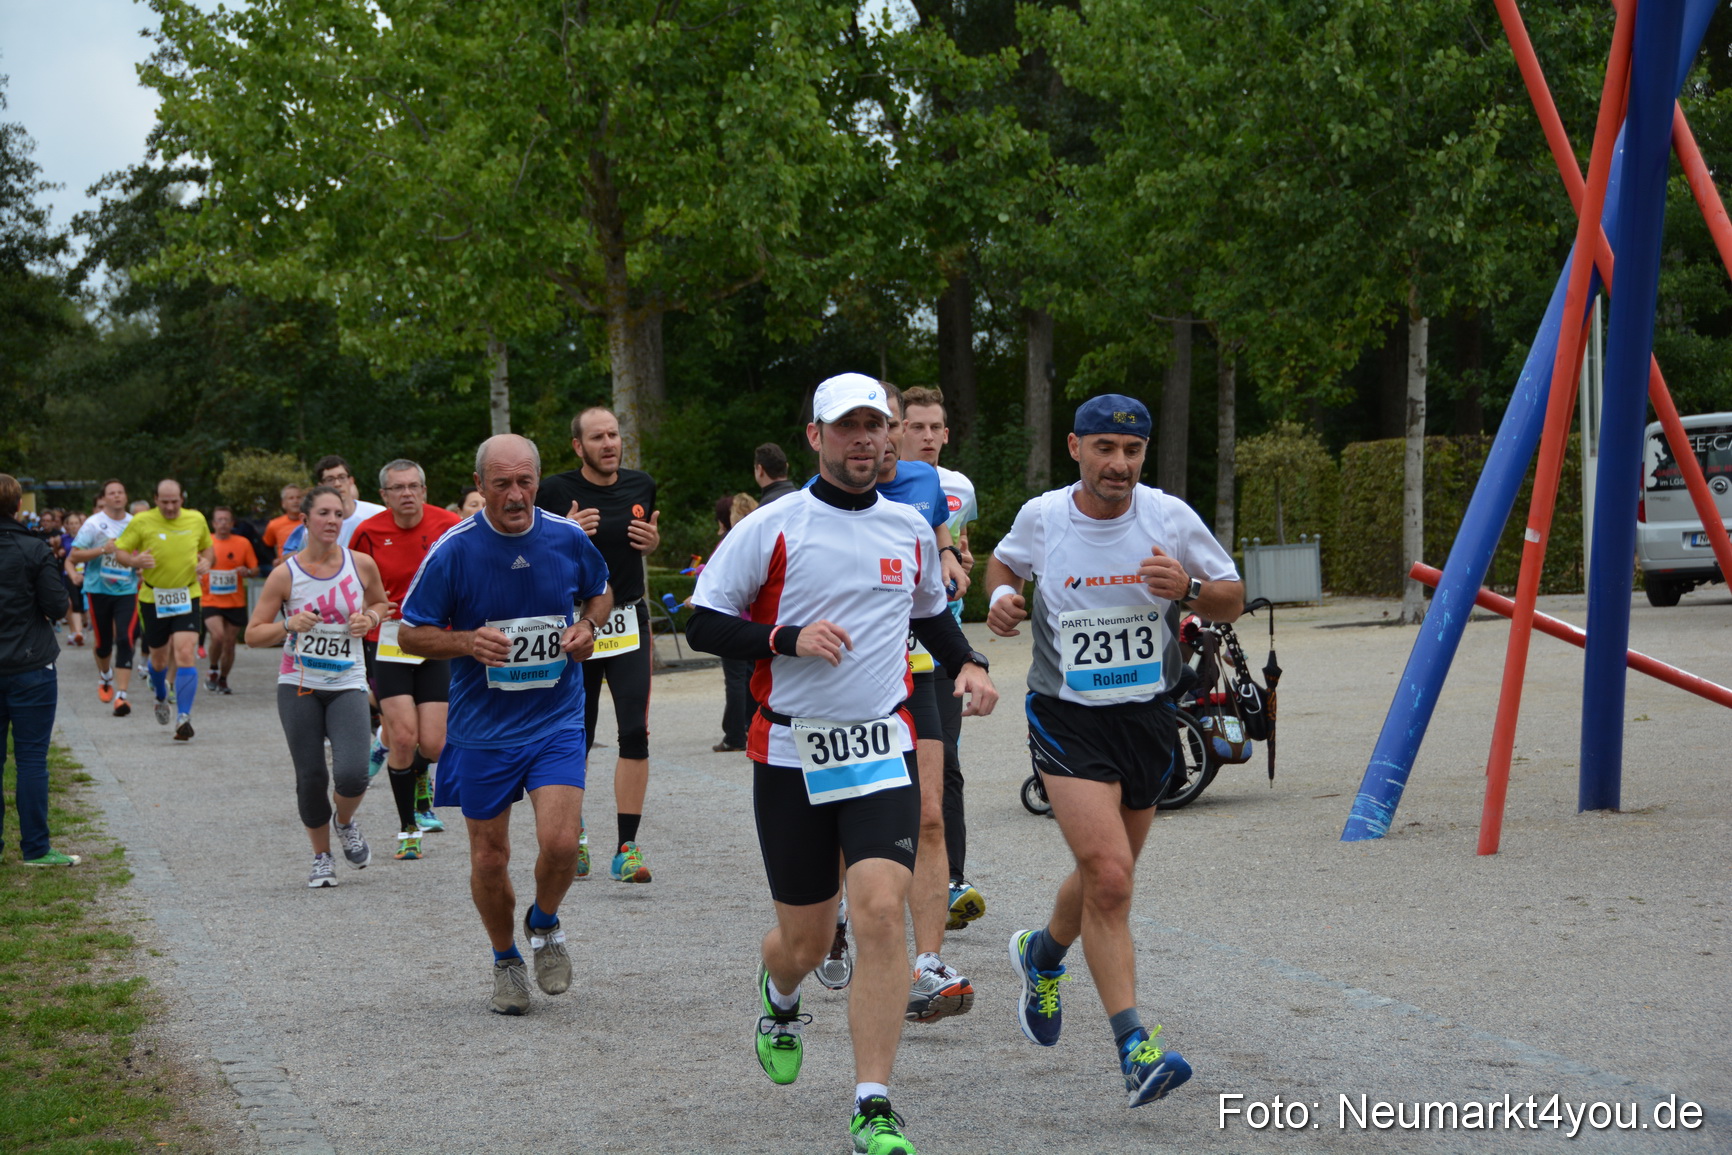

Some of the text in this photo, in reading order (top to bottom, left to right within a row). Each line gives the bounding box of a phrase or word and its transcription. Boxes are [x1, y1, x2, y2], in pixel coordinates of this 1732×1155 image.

[511, 562, 531, 570] adidas
[882, 575, 902, 583] DKMS
[1061, 614, 1144, 628] PARTL Neumarkt
[302, 635, 352, 658] 2054
[495, 631, 561, 664] 248
[598, 640, 619, 650] PuTo
[1072, 626, 1154, 666] 2313
[307, 658, 342, 670] Susanne
[510, 668, 550, 681] Werner
[1093, 669, 1138, 687] Roland
[807, 721, 891, 765] 3030
